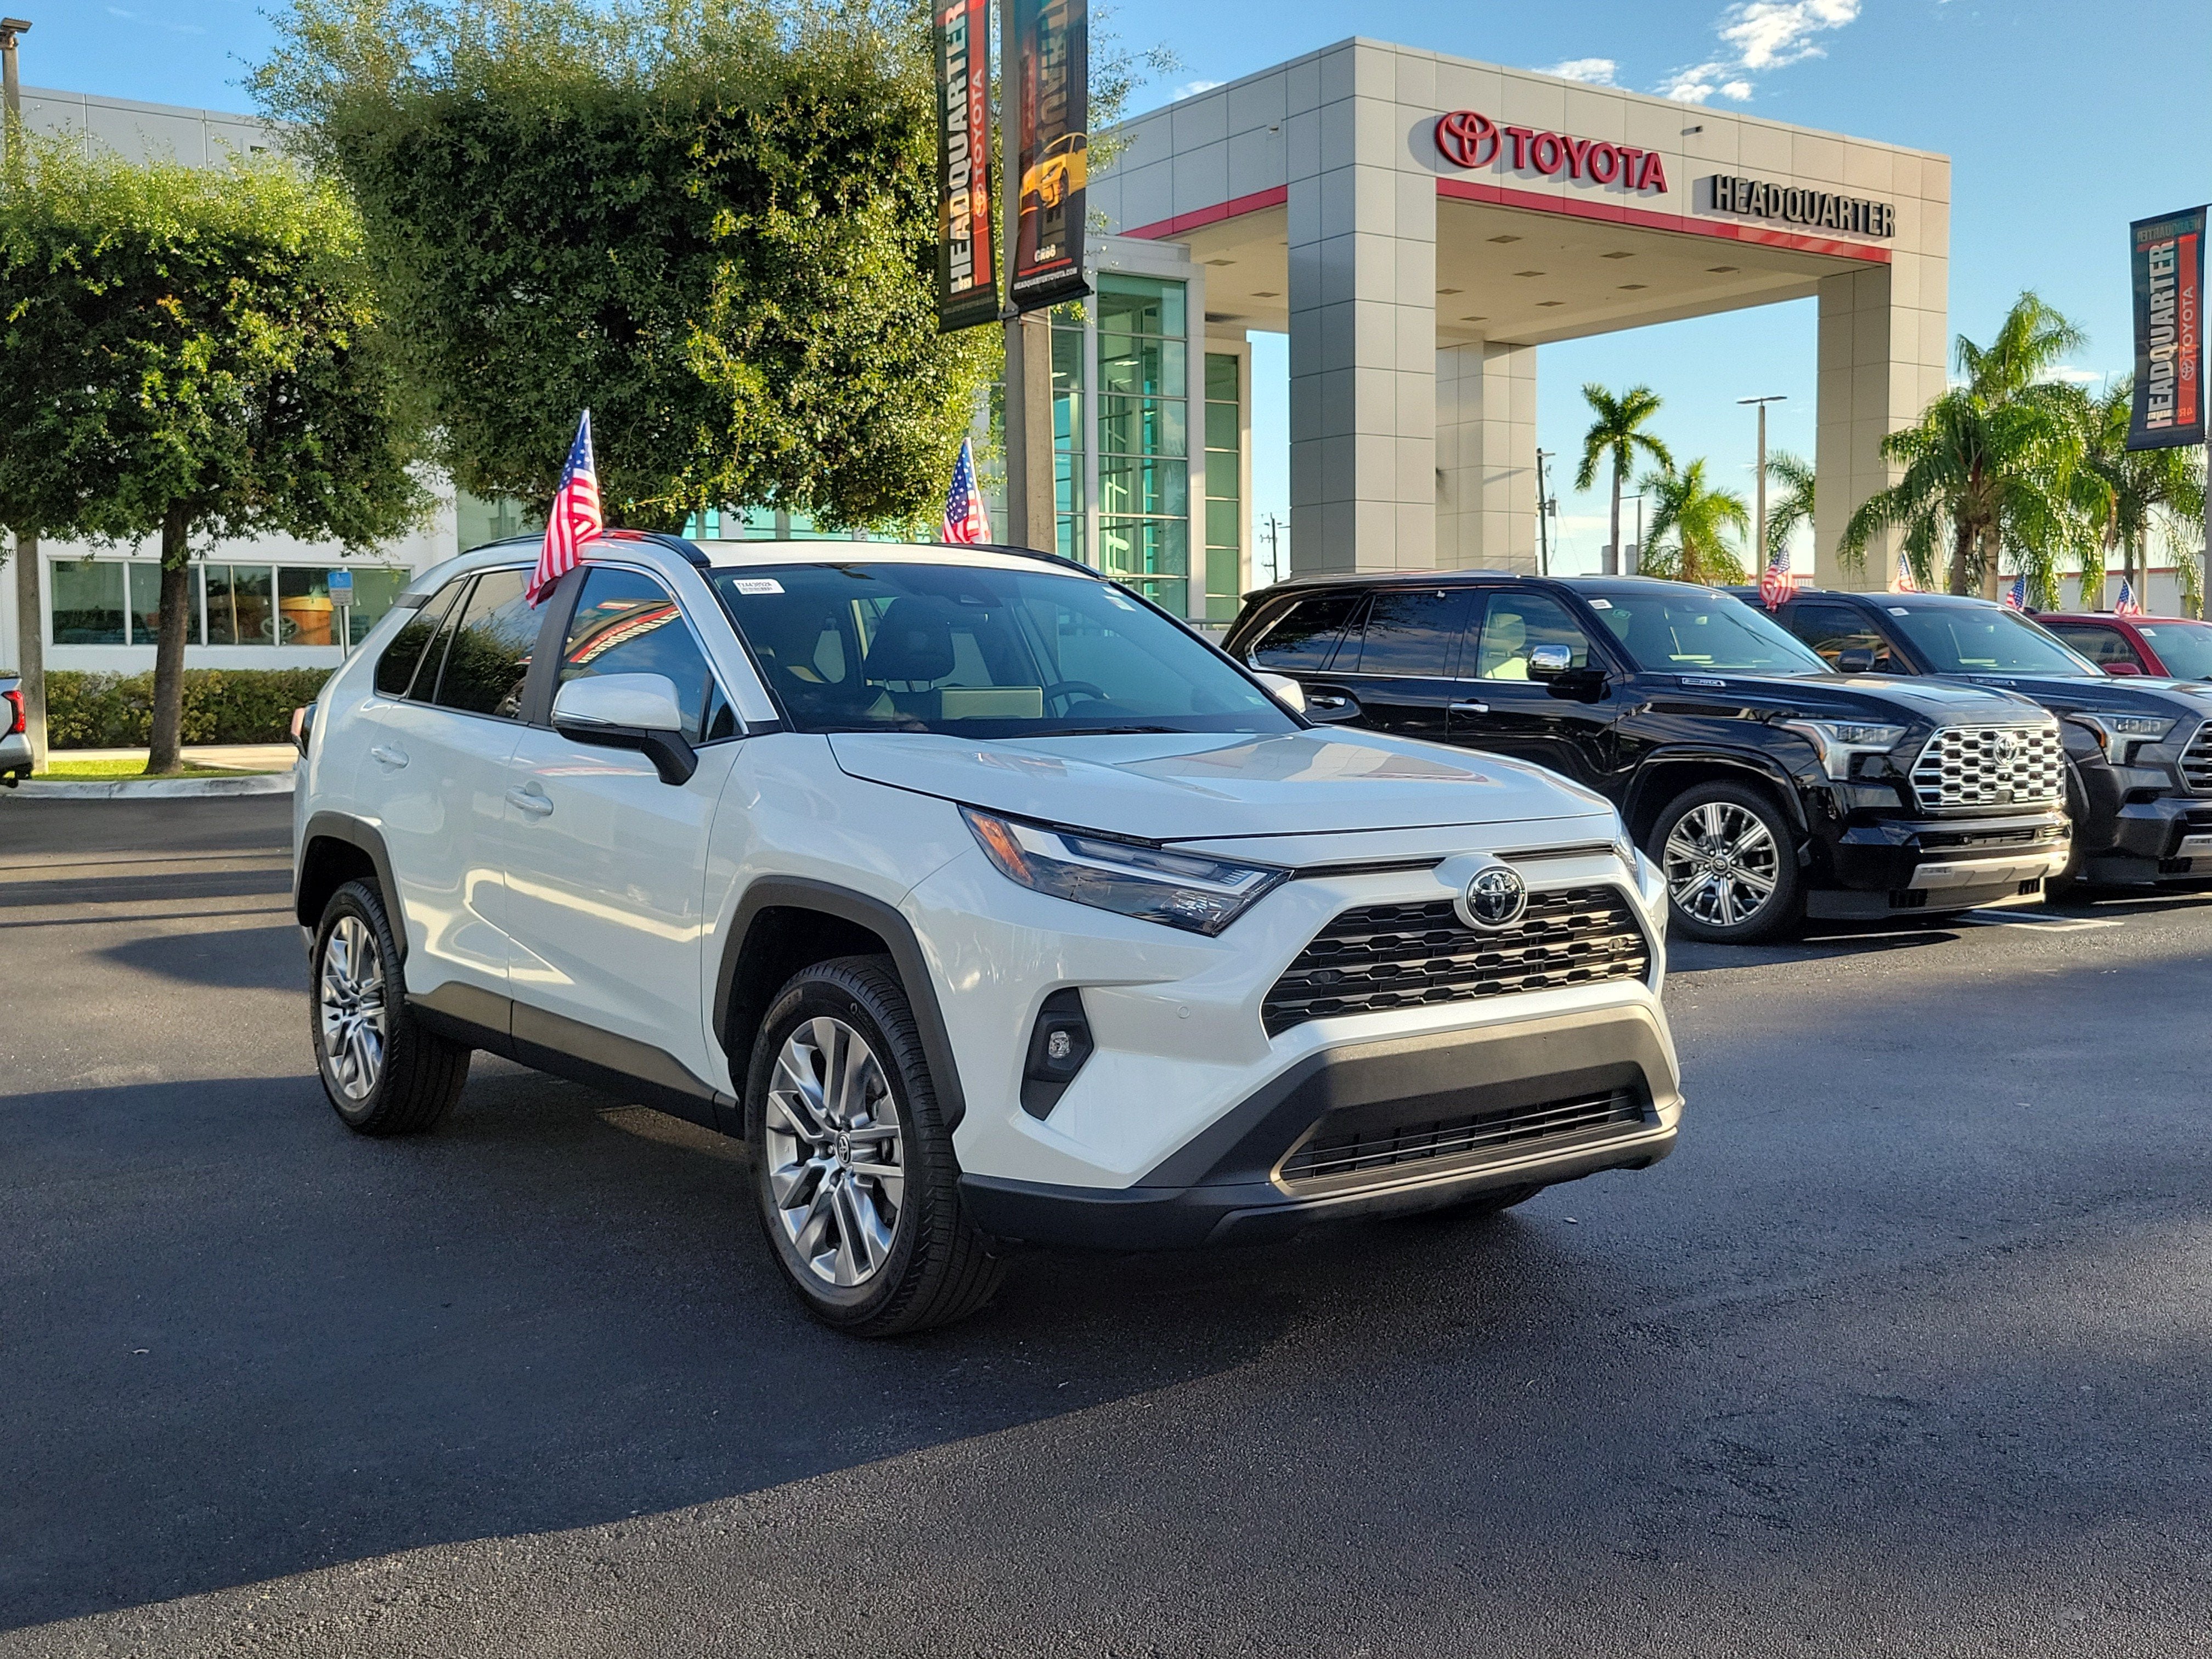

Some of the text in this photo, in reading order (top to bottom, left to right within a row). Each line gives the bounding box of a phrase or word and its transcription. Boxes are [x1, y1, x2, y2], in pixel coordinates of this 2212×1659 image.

[945, 0, 972, 294] HEADQUARTER
[972, 68, 984, 179] TOYOTA
[1505, 126, 1668, 193] TOYOTA
[1712, 174, 1895, 237] HEADQUARTER
[2147, 240, 2178, 430] HEADQUARTER
[2183, 285, 2194, 358] TOYOTA
